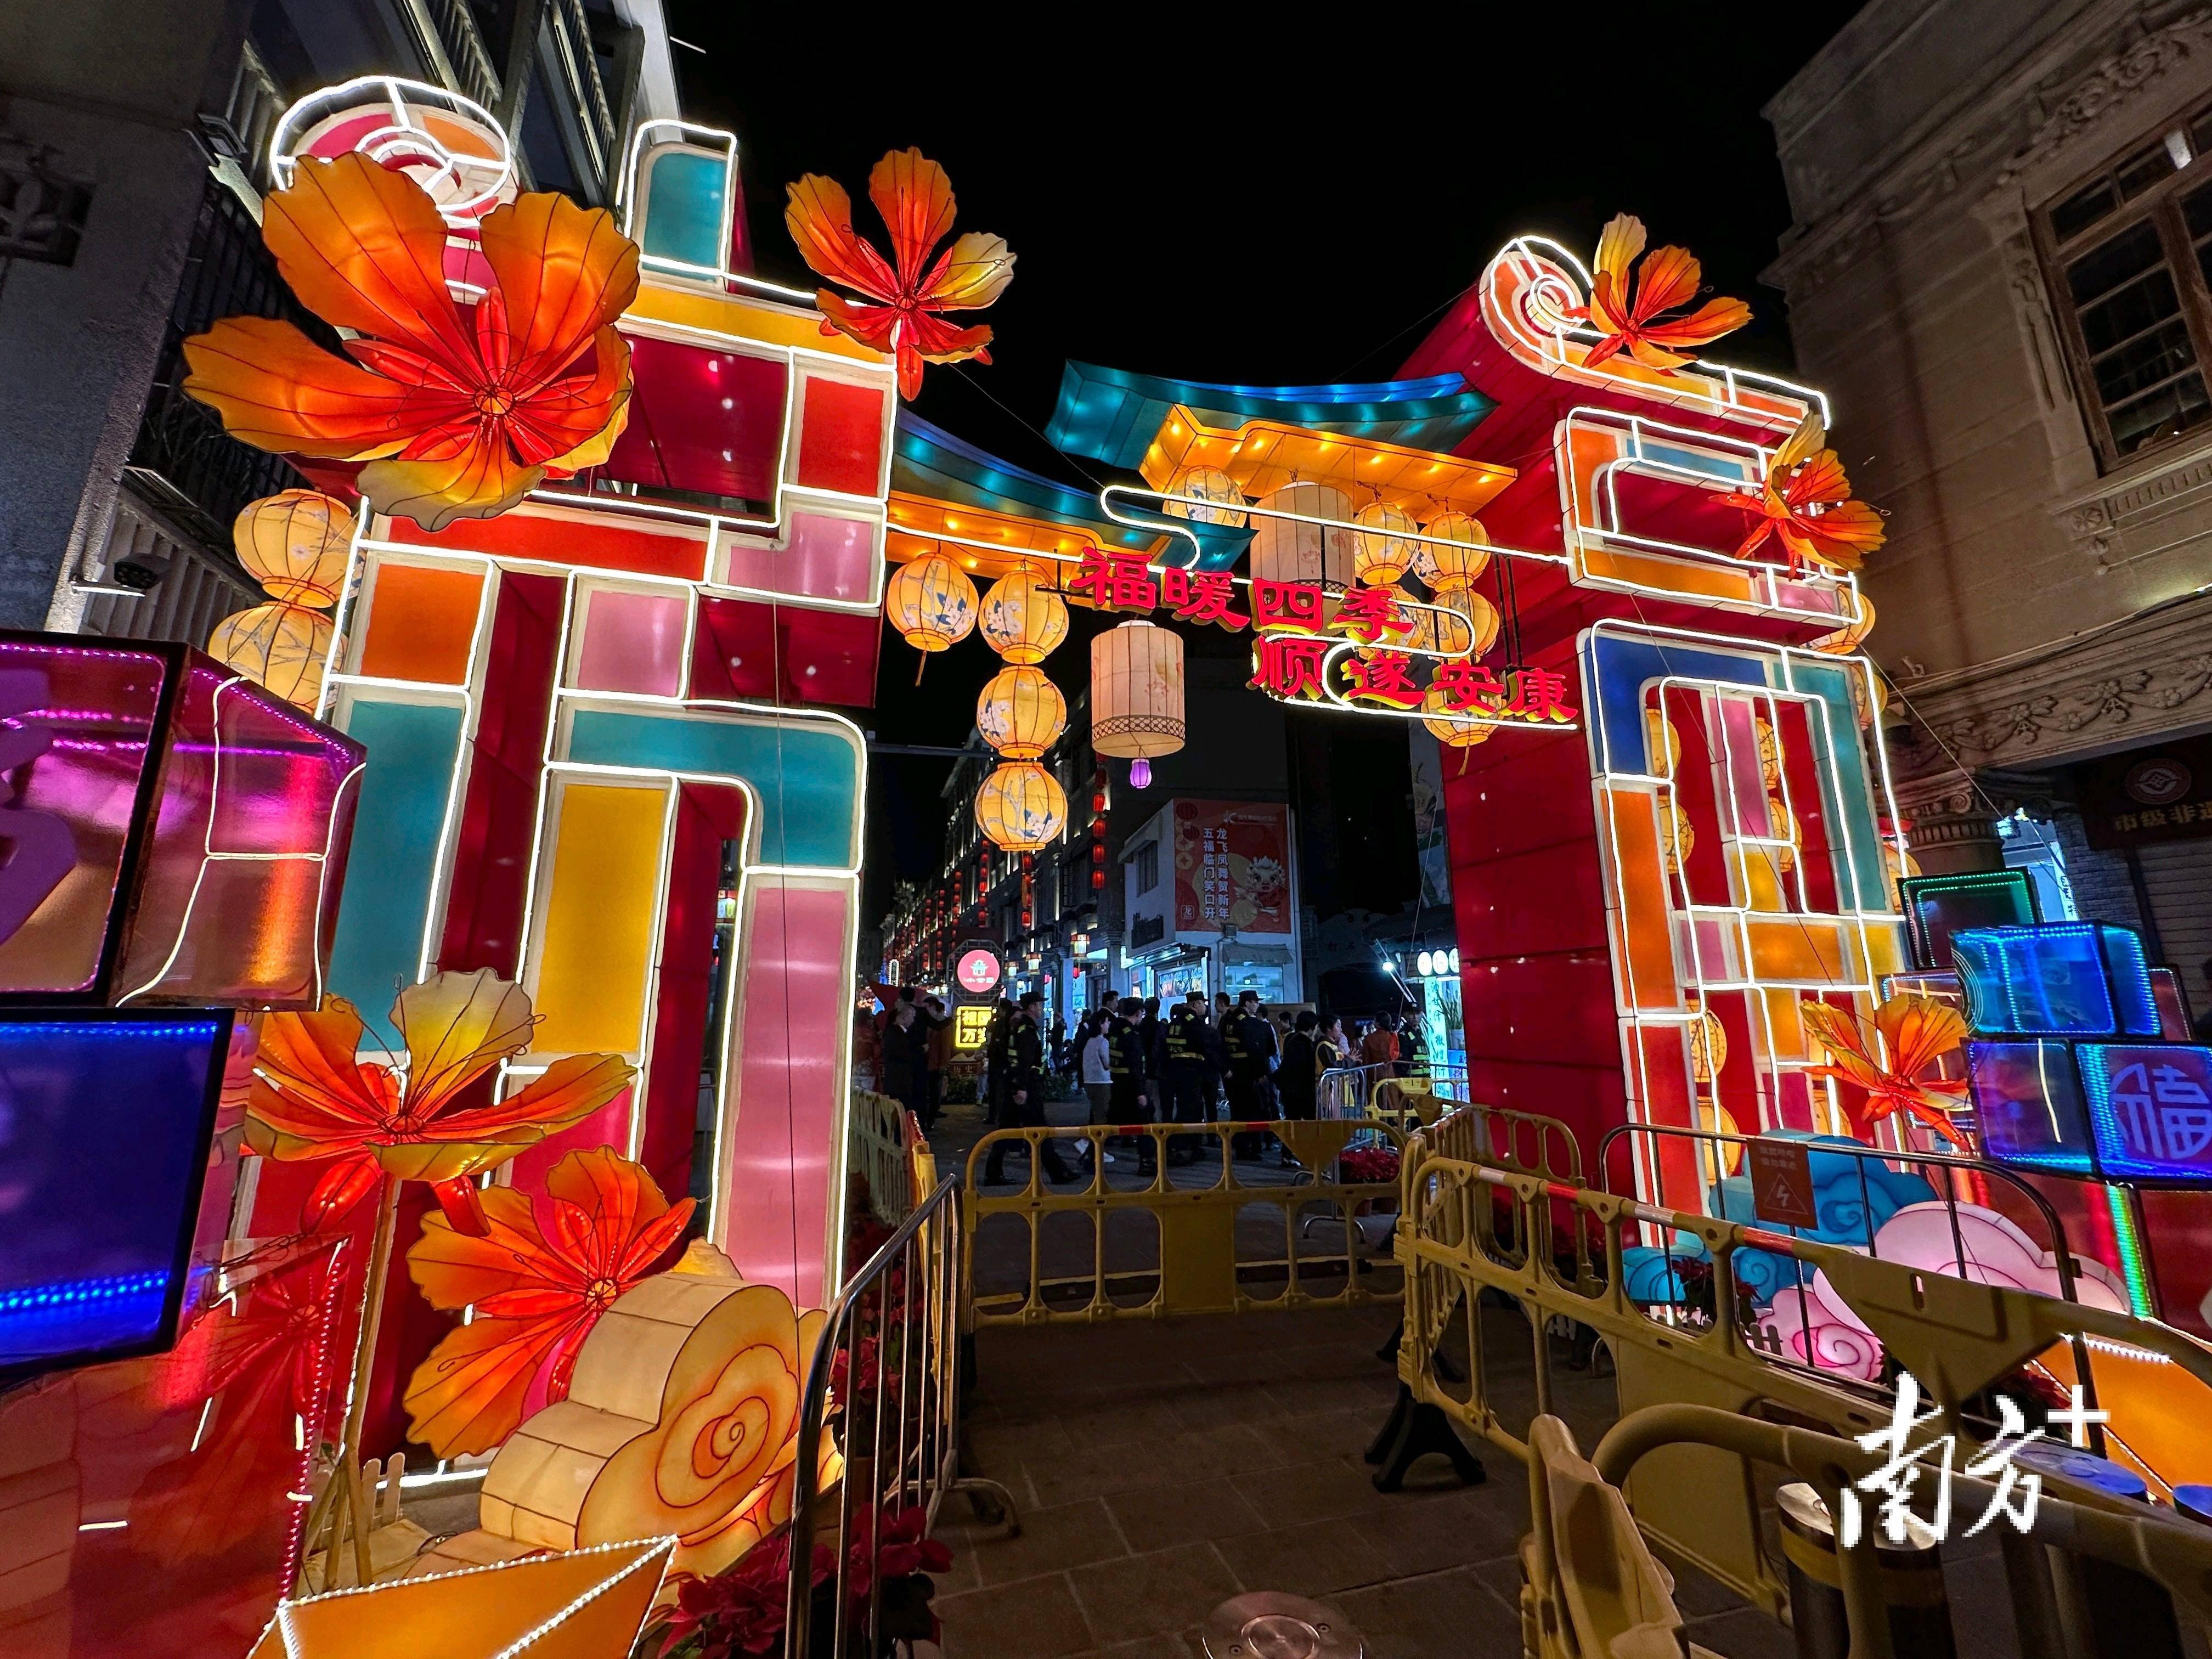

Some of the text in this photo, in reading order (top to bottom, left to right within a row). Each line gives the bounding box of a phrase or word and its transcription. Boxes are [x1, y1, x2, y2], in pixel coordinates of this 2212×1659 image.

[1070, 546, 1415, 644] 福暖四季
[1251, 633, 1578, 721] 顺遂安康
[1203, 828, 1216, 919] 五福临门笑口开
[1217, 828, 1229, 919] 龙飞凤舞贺新年
[2111, 1062, 2212, 1160] 福
